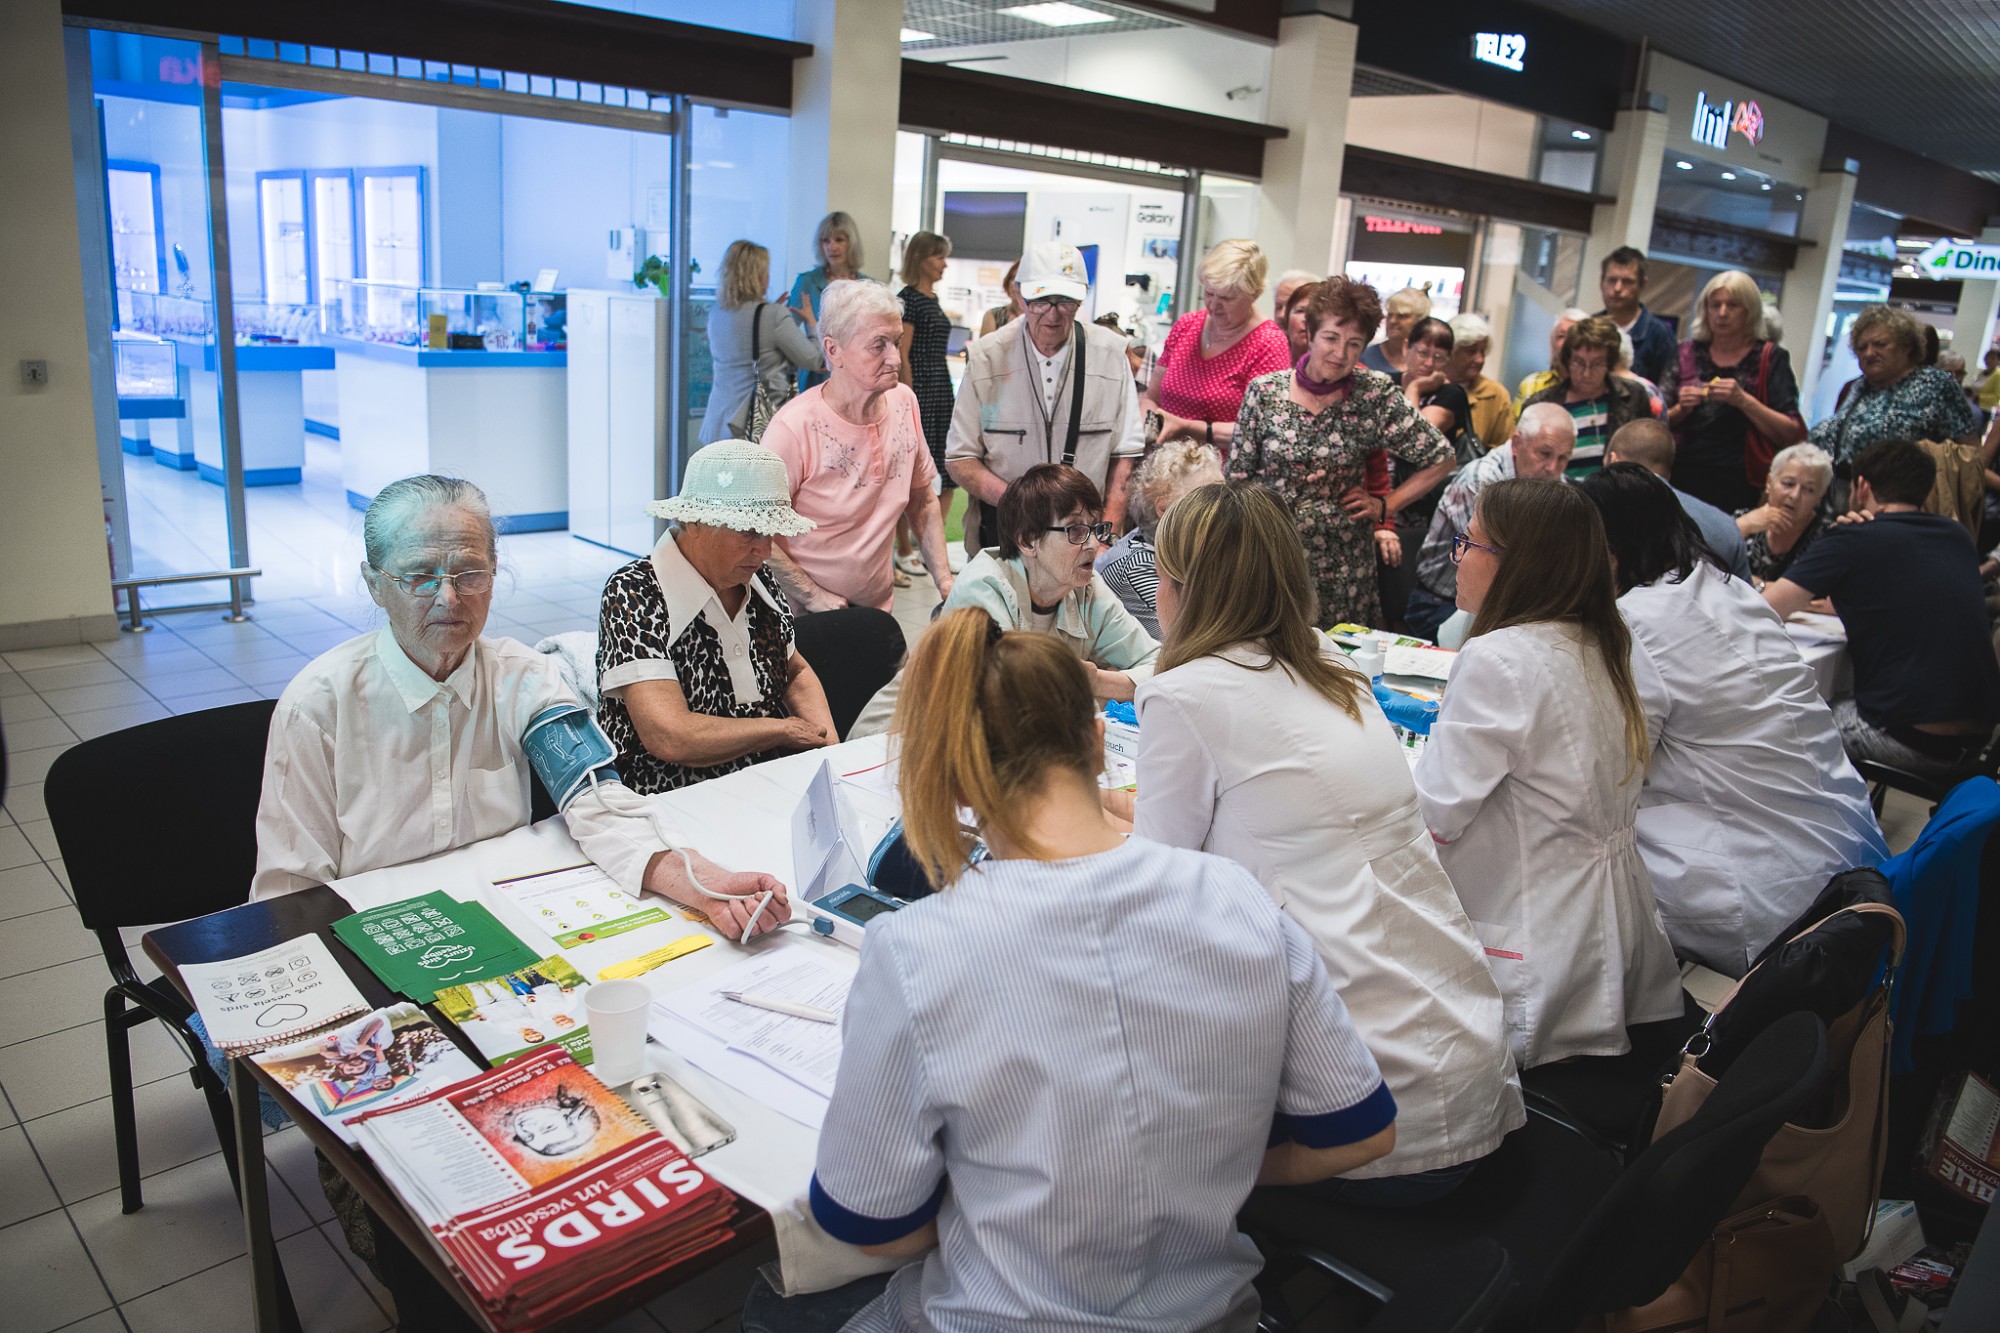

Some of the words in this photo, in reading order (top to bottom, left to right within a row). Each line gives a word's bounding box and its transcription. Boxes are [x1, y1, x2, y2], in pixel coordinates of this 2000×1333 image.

[1476, 33, 1526, 72] TELE2
[1137, 212, 1175, 227] Galaxy
[1954, 250, 2000, 272] Din
[1104, 740, 1124, 753] ouch
[443, 945, 476, 959] Uzturs
[417, 956, 443, 967] sirds
[294, 980, 323, 994] 100%
[253, 993, 292, 1006] vesela
[220, 1004, 249, 1012] sirds
[574, 1180, 611, 1203] un
[476, 1198, 577, 1241] veselība
[497, 1158, 704, 1271] SIRDS
